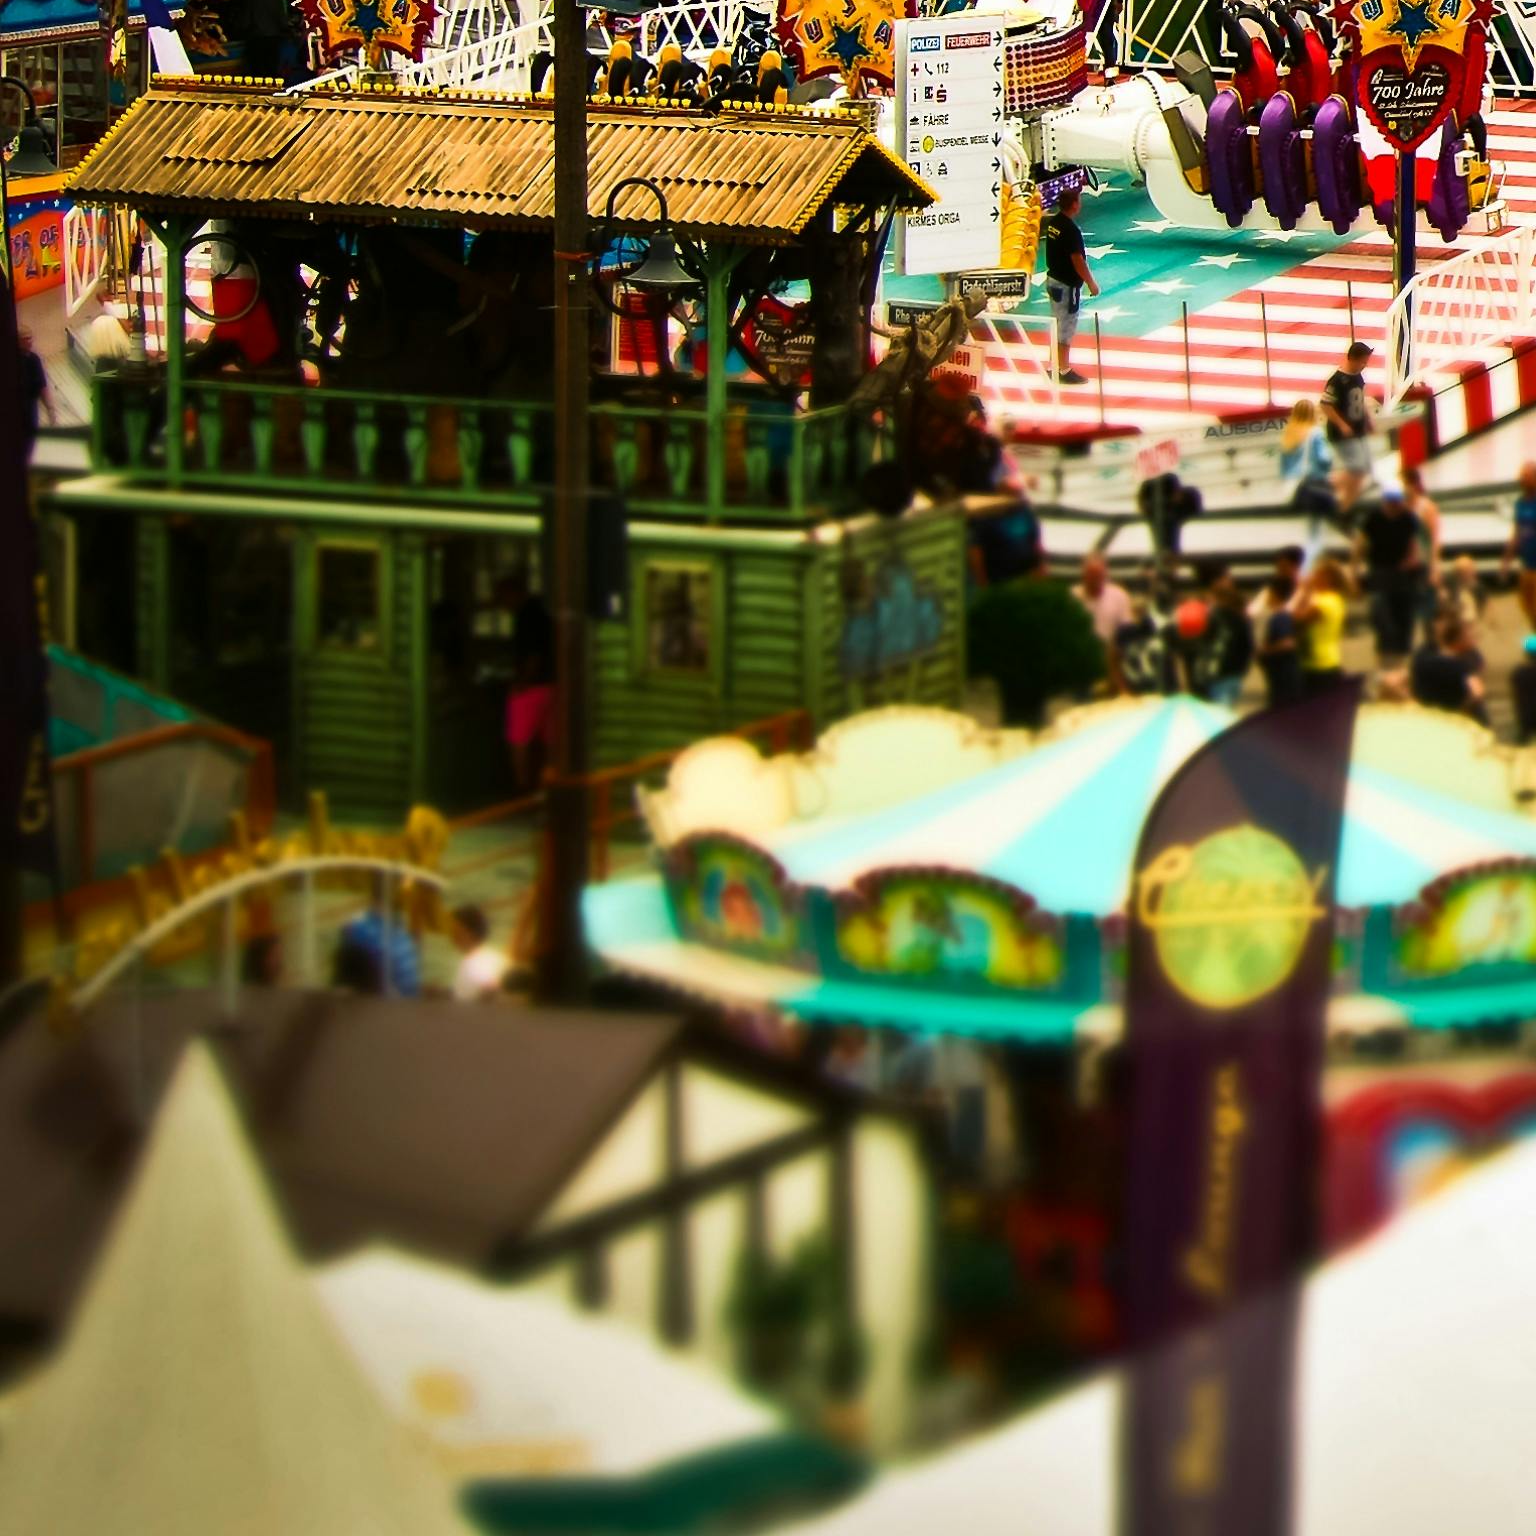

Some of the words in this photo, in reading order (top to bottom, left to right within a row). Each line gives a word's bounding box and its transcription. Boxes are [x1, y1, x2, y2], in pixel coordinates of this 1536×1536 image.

[911, 37, 940, 51] POLIZEI
[946, 34, 991, 48] FEUERWEHR
[1372, 85, 1401, 105] 700
[1404, 76, 1445, 100] Jahre
